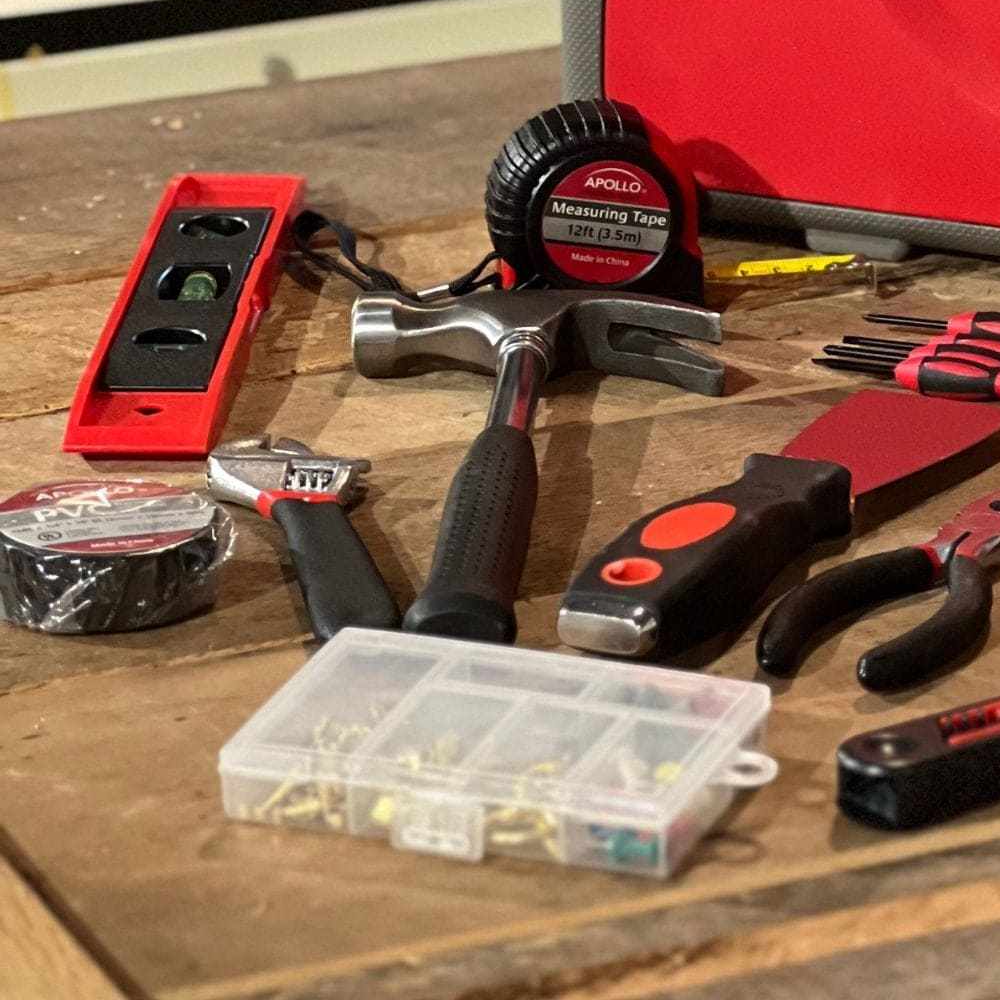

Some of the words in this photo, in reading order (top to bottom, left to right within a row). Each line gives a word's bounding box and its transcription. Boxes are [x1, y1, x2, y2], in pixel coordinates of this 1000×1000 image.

[584, 177, 641, 193] APOLLO
[552, 201, 628, 224] Measuring
[633, 210, 667, 227] Tape
[567, 223, 594, 237] 12ft
[598, 228, 641, 245] (3.5m)
[571, 252, 594, 263] Made
[596, 256, 604, 264] in
[606, 256, 630, 267] China
